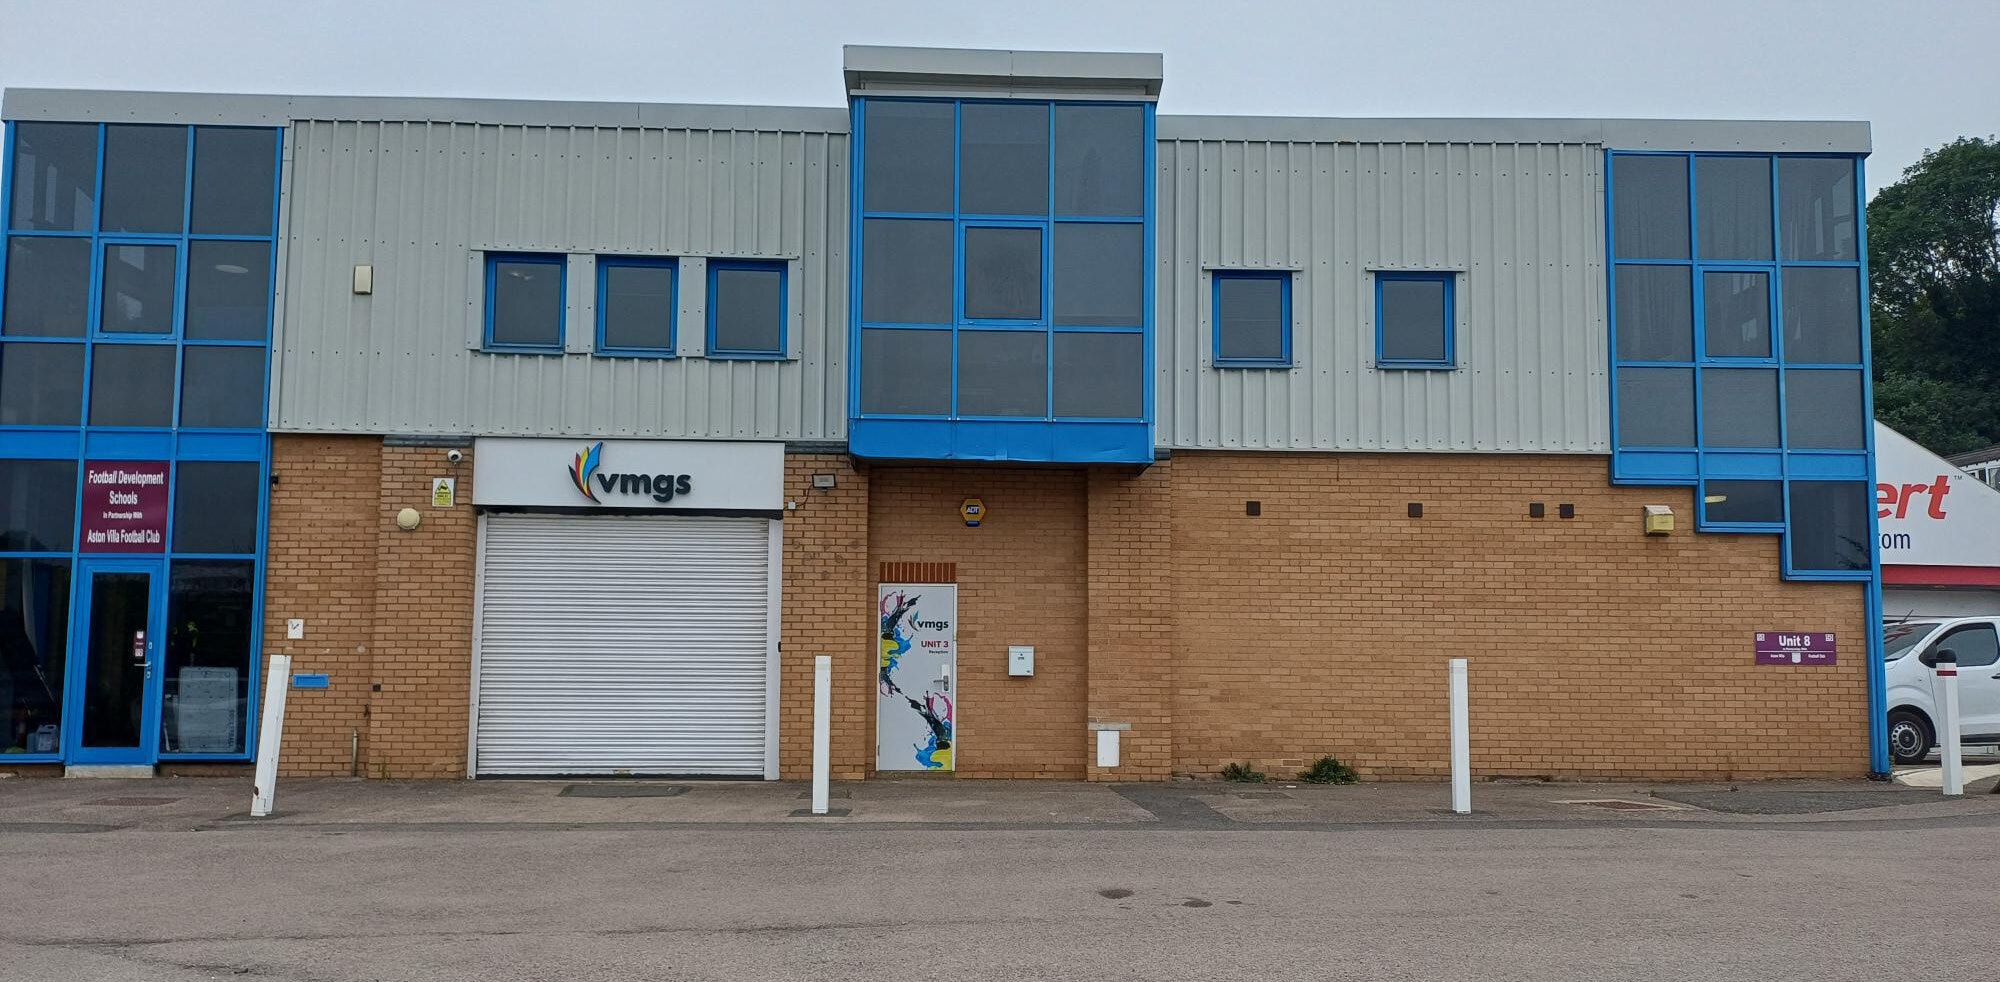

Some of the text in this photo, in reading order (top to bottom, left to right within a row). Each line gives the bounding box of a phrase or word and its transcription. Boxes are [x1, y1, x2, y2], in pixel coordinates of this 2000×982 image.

[88, 469, 164, 488] Football Development
[596, 473, 691, 503] vmgs
[109, 490, 138, 505] Schools
[1876, 475, 1950, 519] ert
[966, 506, 979, 514] ADT
[87, 529, 160, 543] Aston Villa Football Club
[1879, 533, 1911, 549] om
[917, 620, 949, 631] vmgs
[921, 640, 949, 648] UNIT 3
[1778, 635, 1811, 647] Unit 8
